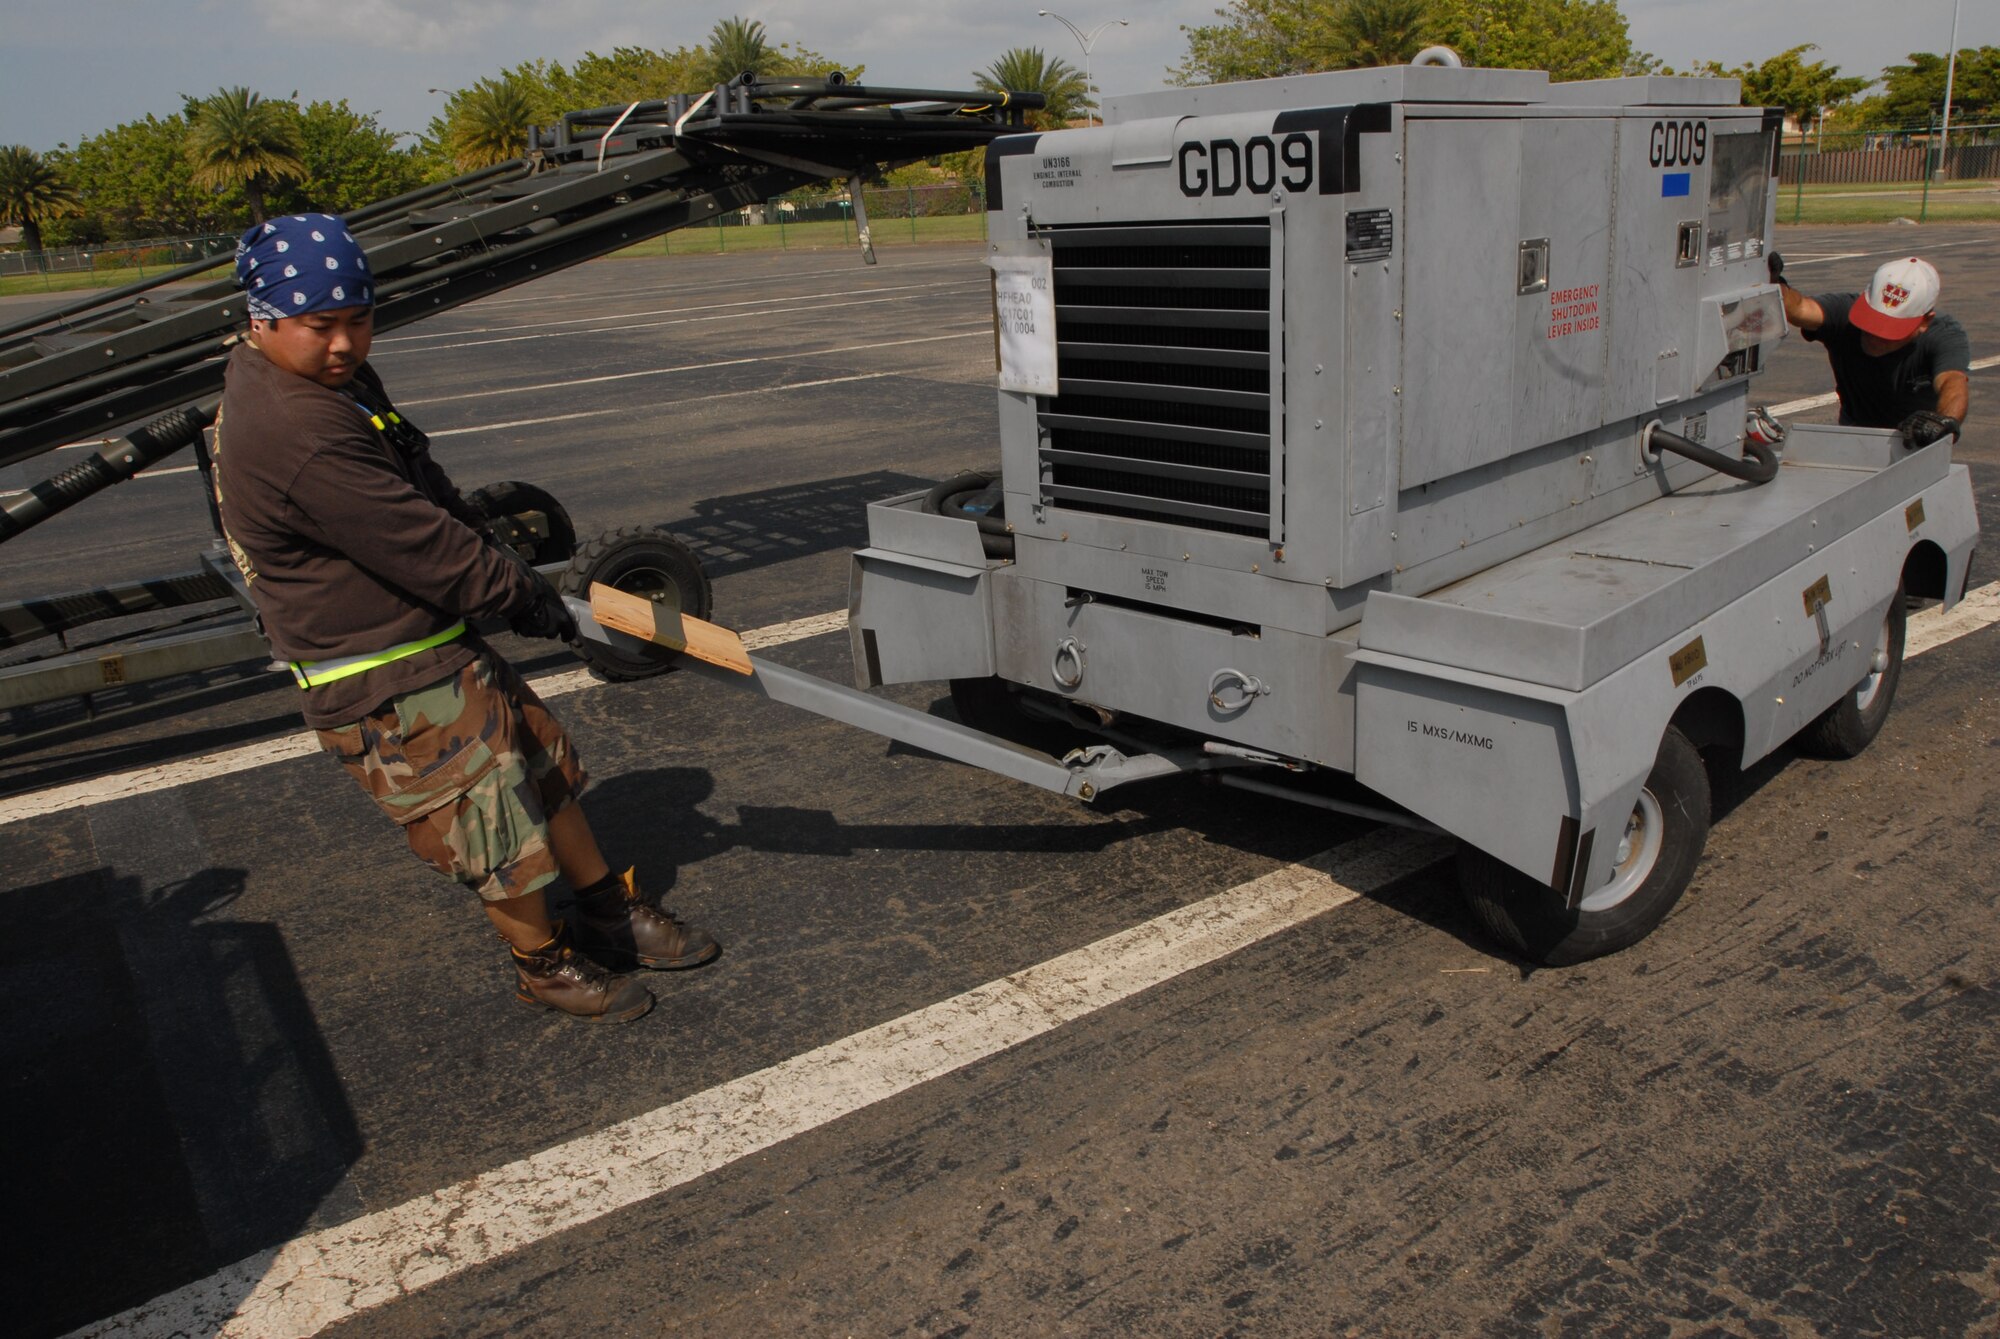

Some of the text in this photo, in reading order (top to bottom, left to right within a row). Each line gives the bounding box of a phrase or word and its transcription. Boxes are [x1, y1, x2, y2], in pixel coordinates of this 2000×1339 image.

[1649, 121, 1706, 168] GD09
[1043, 156, 1071, 169] UN3166
[1179, 132, 1313, 197] GD09
[1057, 169, 1082, 178] INTERNAL
[1042, 179, 1074, 189] COMBUSTION
[1031, 277, 1047, 290] 002
[1551, 284, 1599, 305] EMERGENCY
[1551, 301, 1598, 322] SHUTDOWN
[1014, 322, 1035, 335] 0004
[1547, 316, 1600, 339] LEVER INSIDE
[1141, 567, 1169, 578] MAX TOW
[1145, 575, 1165, 585] SPEED
[1152, 584, 1167, 592] MPH
[1804, 660, 1819, 679] NOT
[1422, 723, 1493, 750] MXS/MXMG
